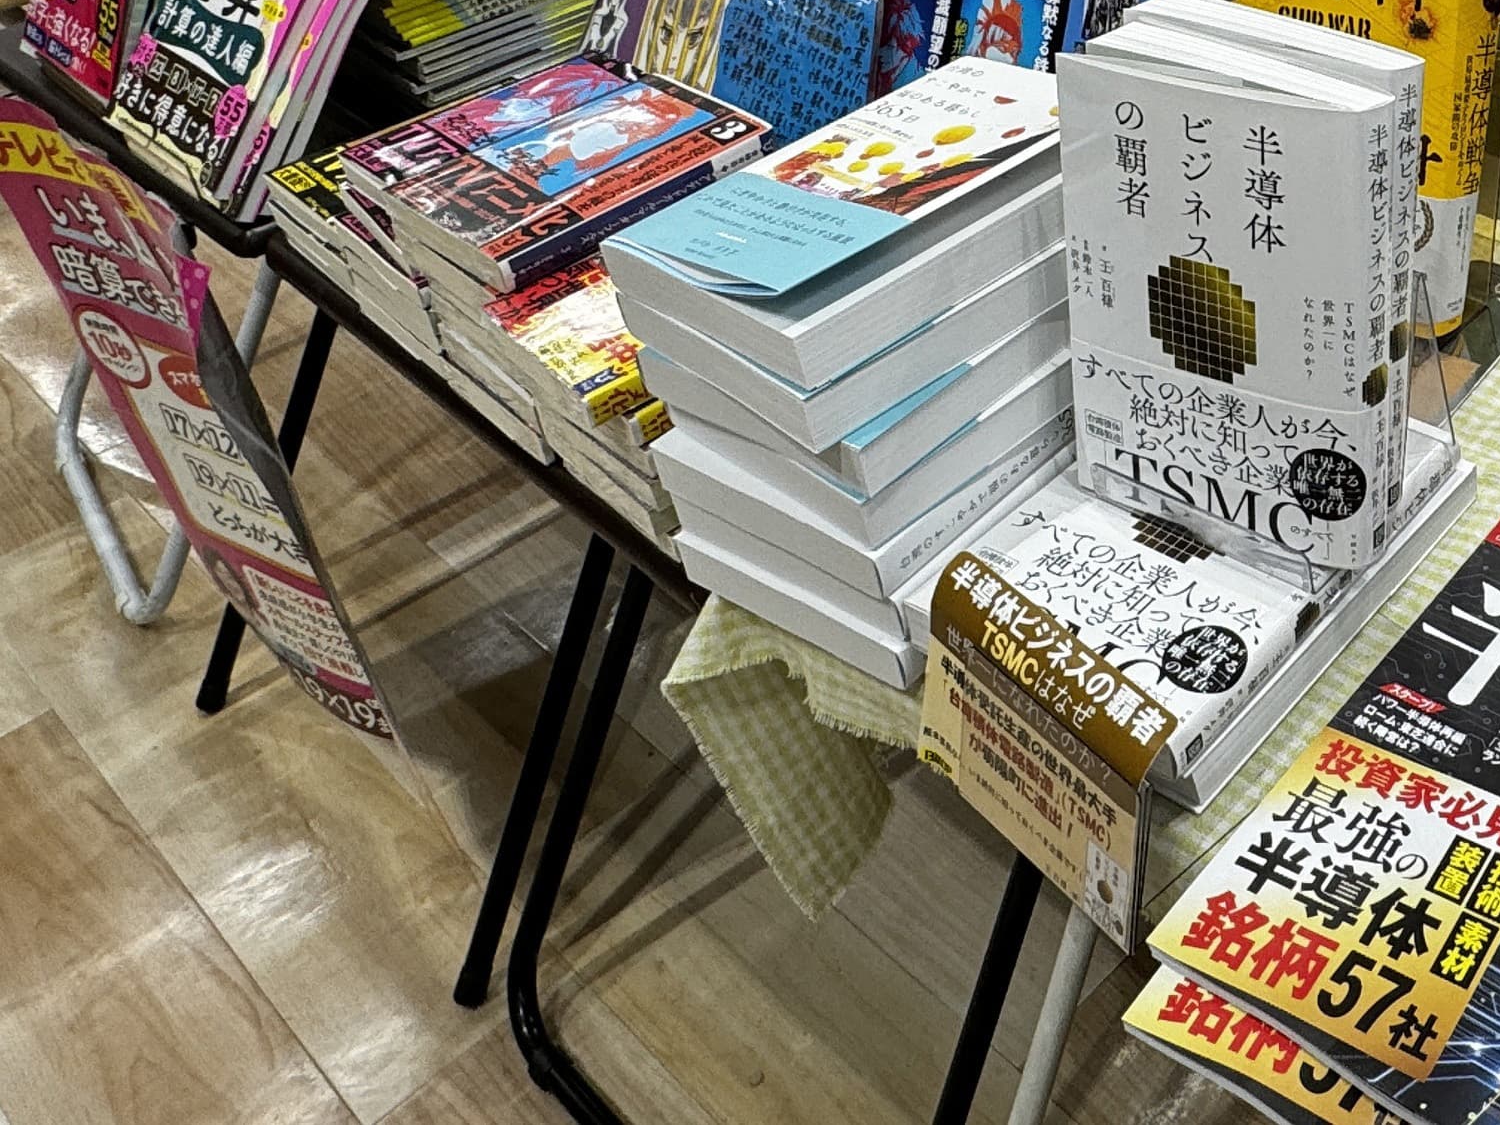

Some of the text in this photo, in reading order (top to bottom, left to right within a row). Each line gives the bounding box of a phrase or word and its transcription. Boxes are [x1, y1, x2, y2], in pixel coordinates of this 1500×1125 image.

[219, 94, 245, 124] 55
[709, 119, 748, 141] 3
[1114, 100, 1149, 219] の覇者
[1181, 111, 1216, 264] ビジネス
[1242, 124, 1288, 255] 半導体
[1391, 82, 1419, 320] 半導体ビジネスの覇者
[1367, 122, 1390, 364] 半導体ビジネスの覇者
[1319, 297, 1337, 353] 世界一に
[1342, 300, 1357, 401] TSMCはなぜ
[1077, 353, 1358, 454] すべての企業人が今、
[1128, 393, 1300, 463] 絶対に知って
[1114, 447, 1316, 555] TSMC
[1135, 426, 1298, 499] おくべき企業
[1296, 465, 1361, 488] 依存する
[1302, 452, 1355, 474] 世界が
[1302, 496, 1354, 517] の存在
[1008, 508, 1264, 646] すべての企業人が今、
[1289, 523, 1335, 543] のすべて
[1024, 570, 1177, 658] おくべき企業
[1034, 546, 1202, 633] 絶対に知って
[950, 557, 1169, 747] 半導体ビジネスの覇者
[979, 618, 1097, 732] TSMCはなぜ
[1362, 703, 1461, 758] ローム・東芝連合に
[1372, 692, 1468, 746] パワー半導体再編
[1271, 777, 1430, 882] 最強の
[1427, 836, 1489, 902] 装置
[1232, 829, 1443, 962] 半導体
[1179, 888, 1442, 1062] 銘柄57社
[1431, 915, 1491, 982] 素材
